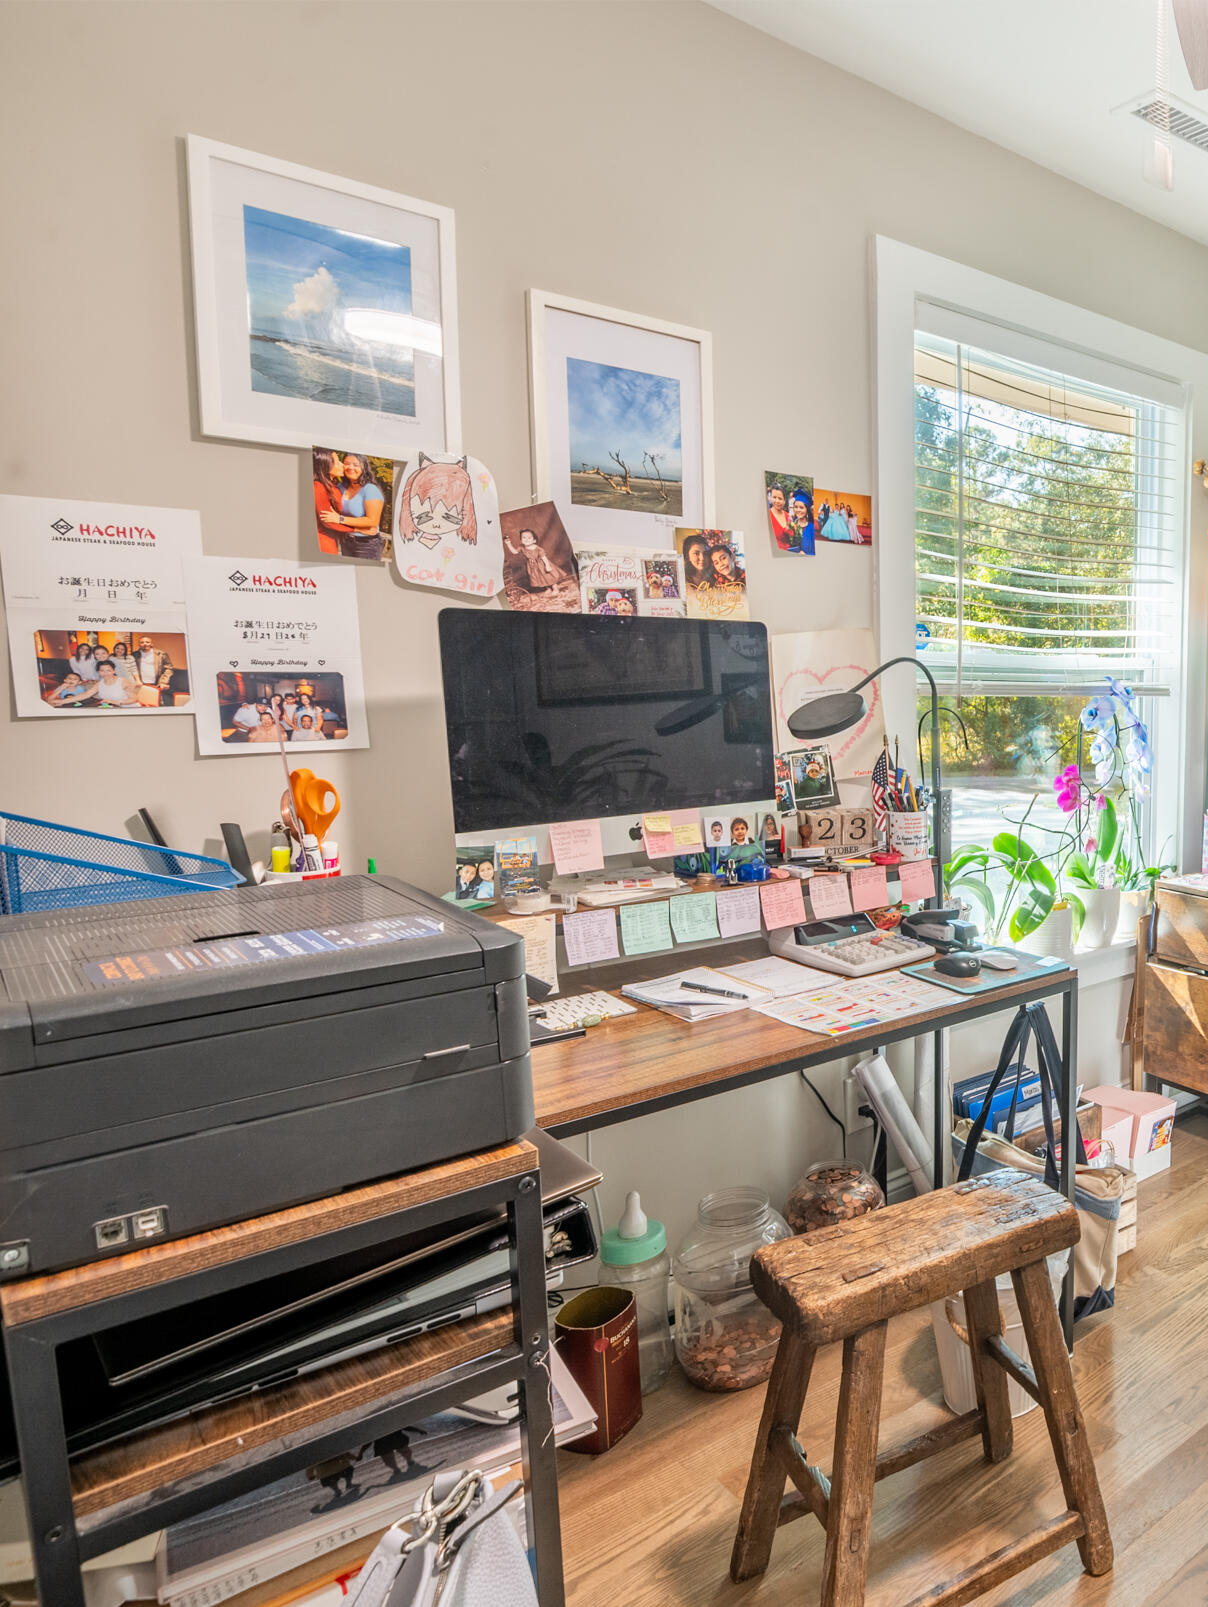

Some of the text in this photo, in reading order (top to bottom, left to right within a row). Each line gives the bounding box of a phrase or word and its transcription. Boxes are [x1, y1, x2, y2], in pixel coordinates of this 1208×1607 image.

[80, 523, 156, 540] HACHIYA
[58, 576, 158, 589] お誕生日おめでとう
[252, 575, 317, 588] HACHIYA
[78, 588, 148, 600] 月 日 年
[78, 616, 146, 625] Happy Birthday
[277, 659, 308, 667] Birthday
[824, 846, 859, 855] CTOBER
